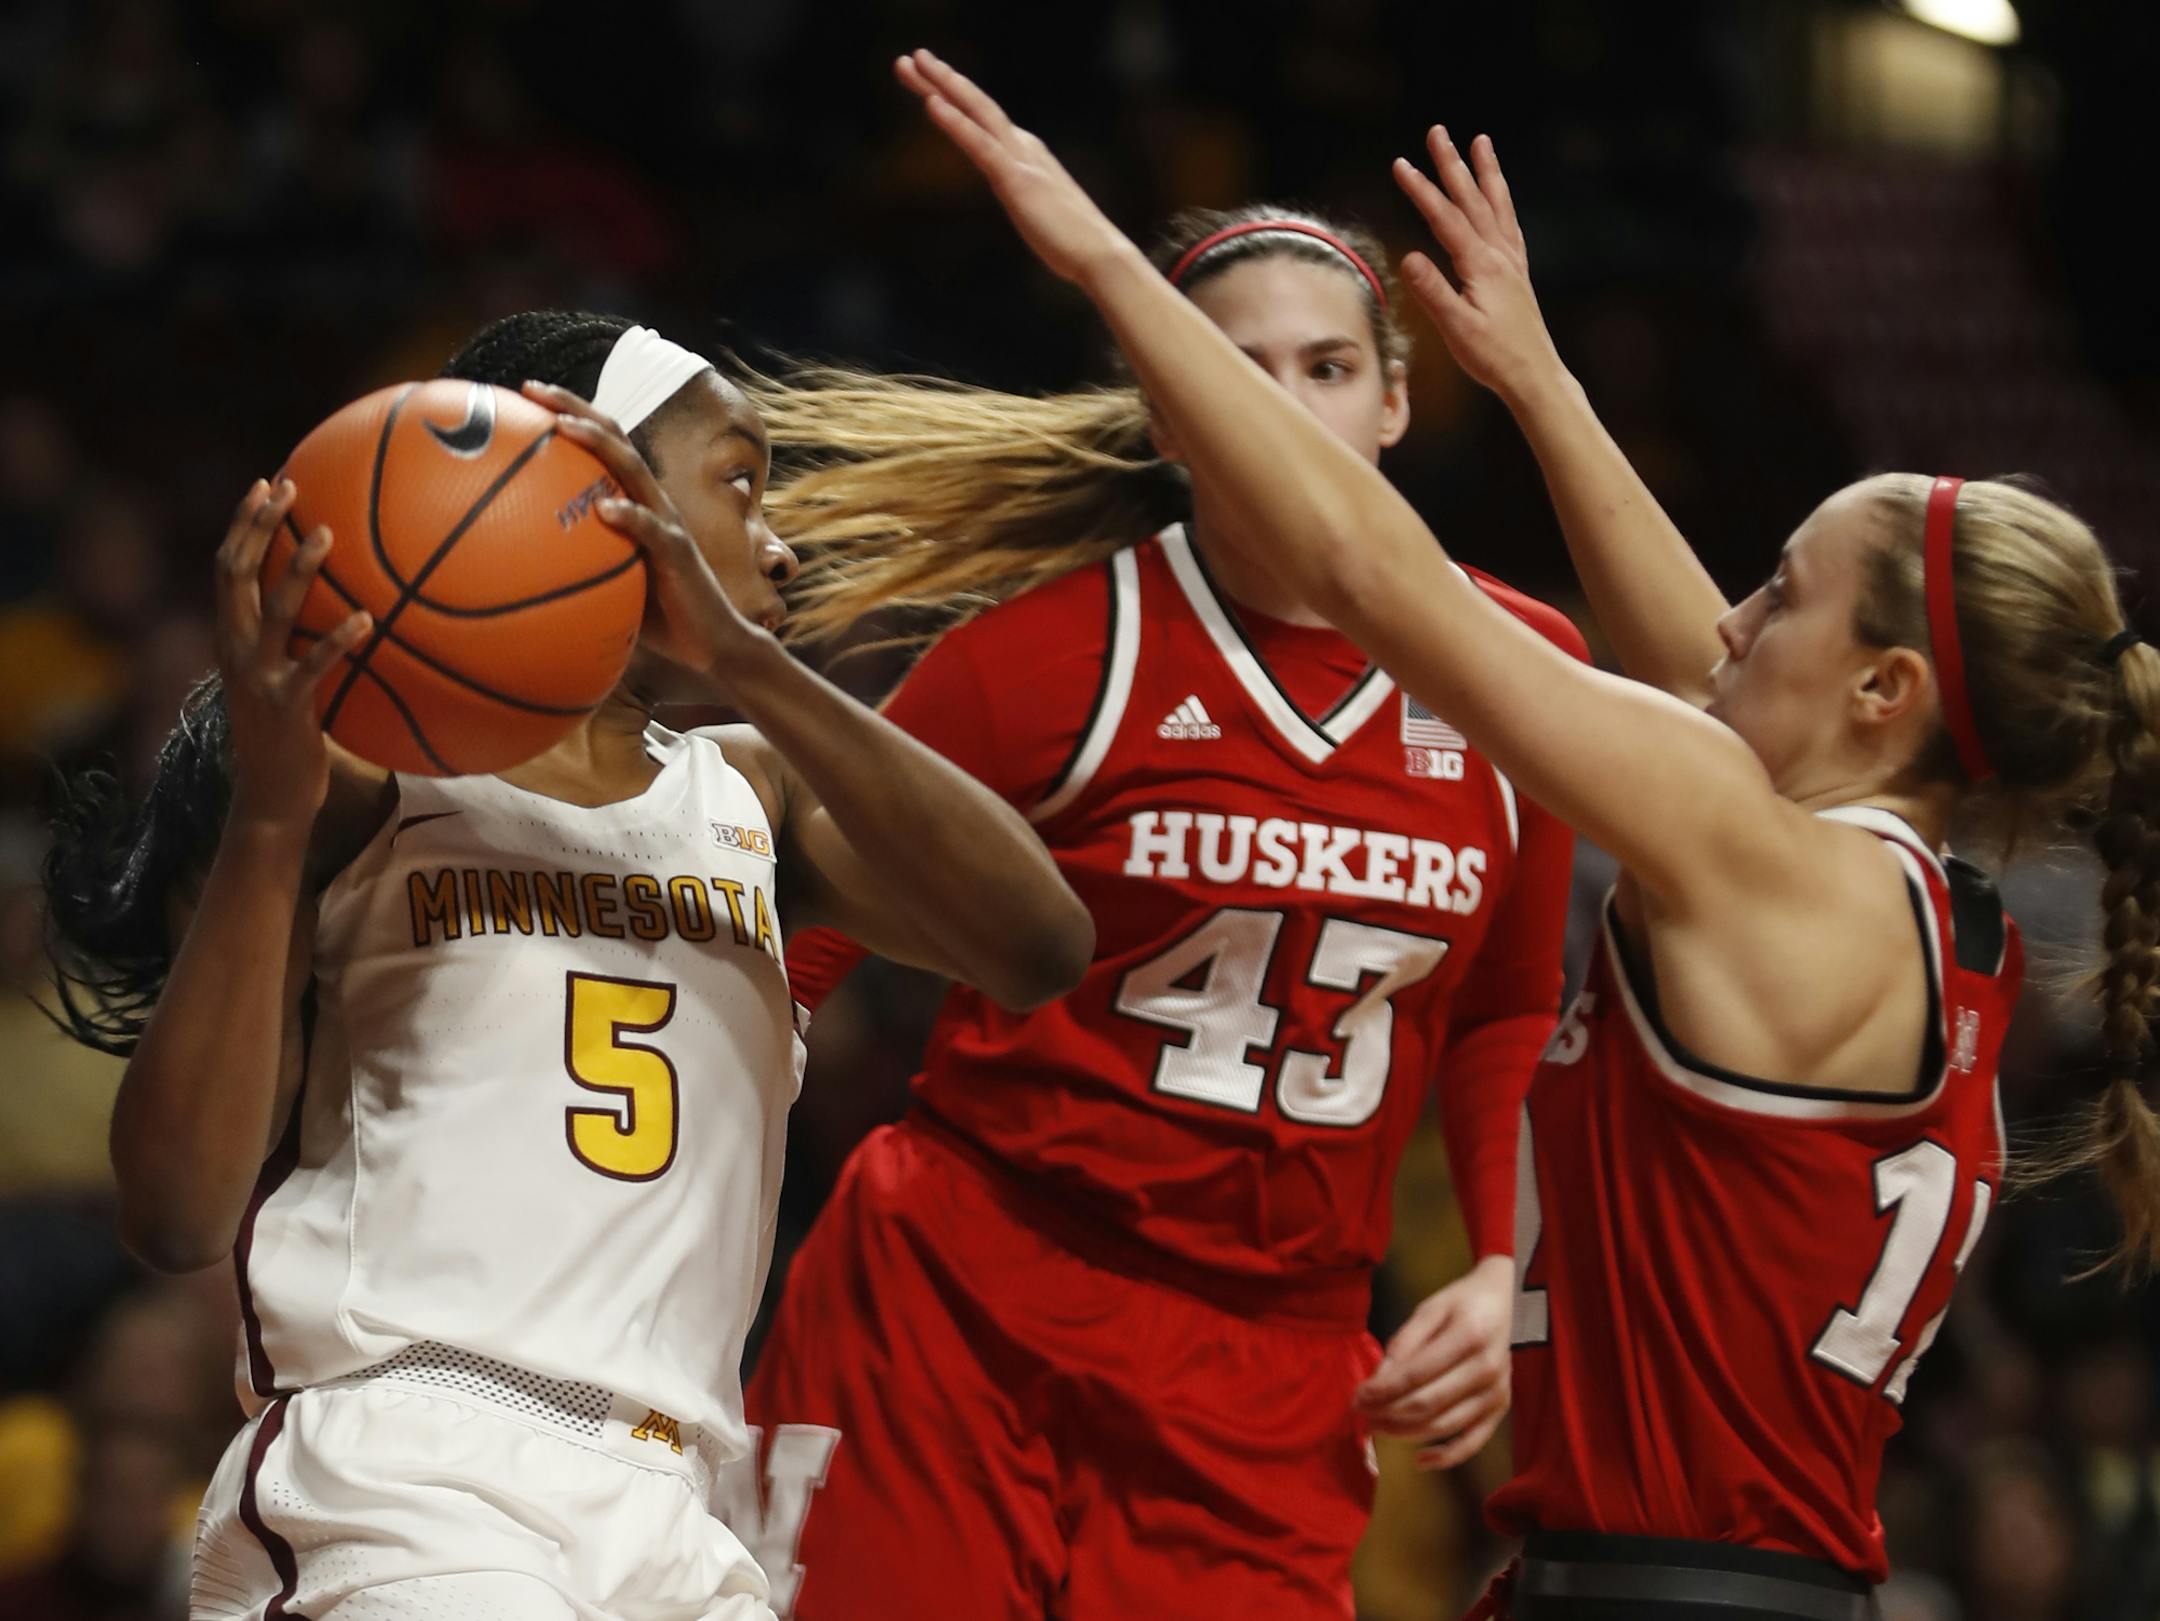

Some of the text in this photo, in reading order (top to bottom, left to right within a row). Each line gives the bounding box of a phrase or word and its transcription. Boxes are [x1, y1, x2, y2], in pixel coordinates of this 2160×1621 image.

[1156, 723, 1222, 740] adidas
[1124, 811, 1487, 916] HUSKERS
[408, 868, 781, 965] MINNESOTA
[1116, 907, 1449, 1127] 43
[564, 970, 679, 1182] 5
